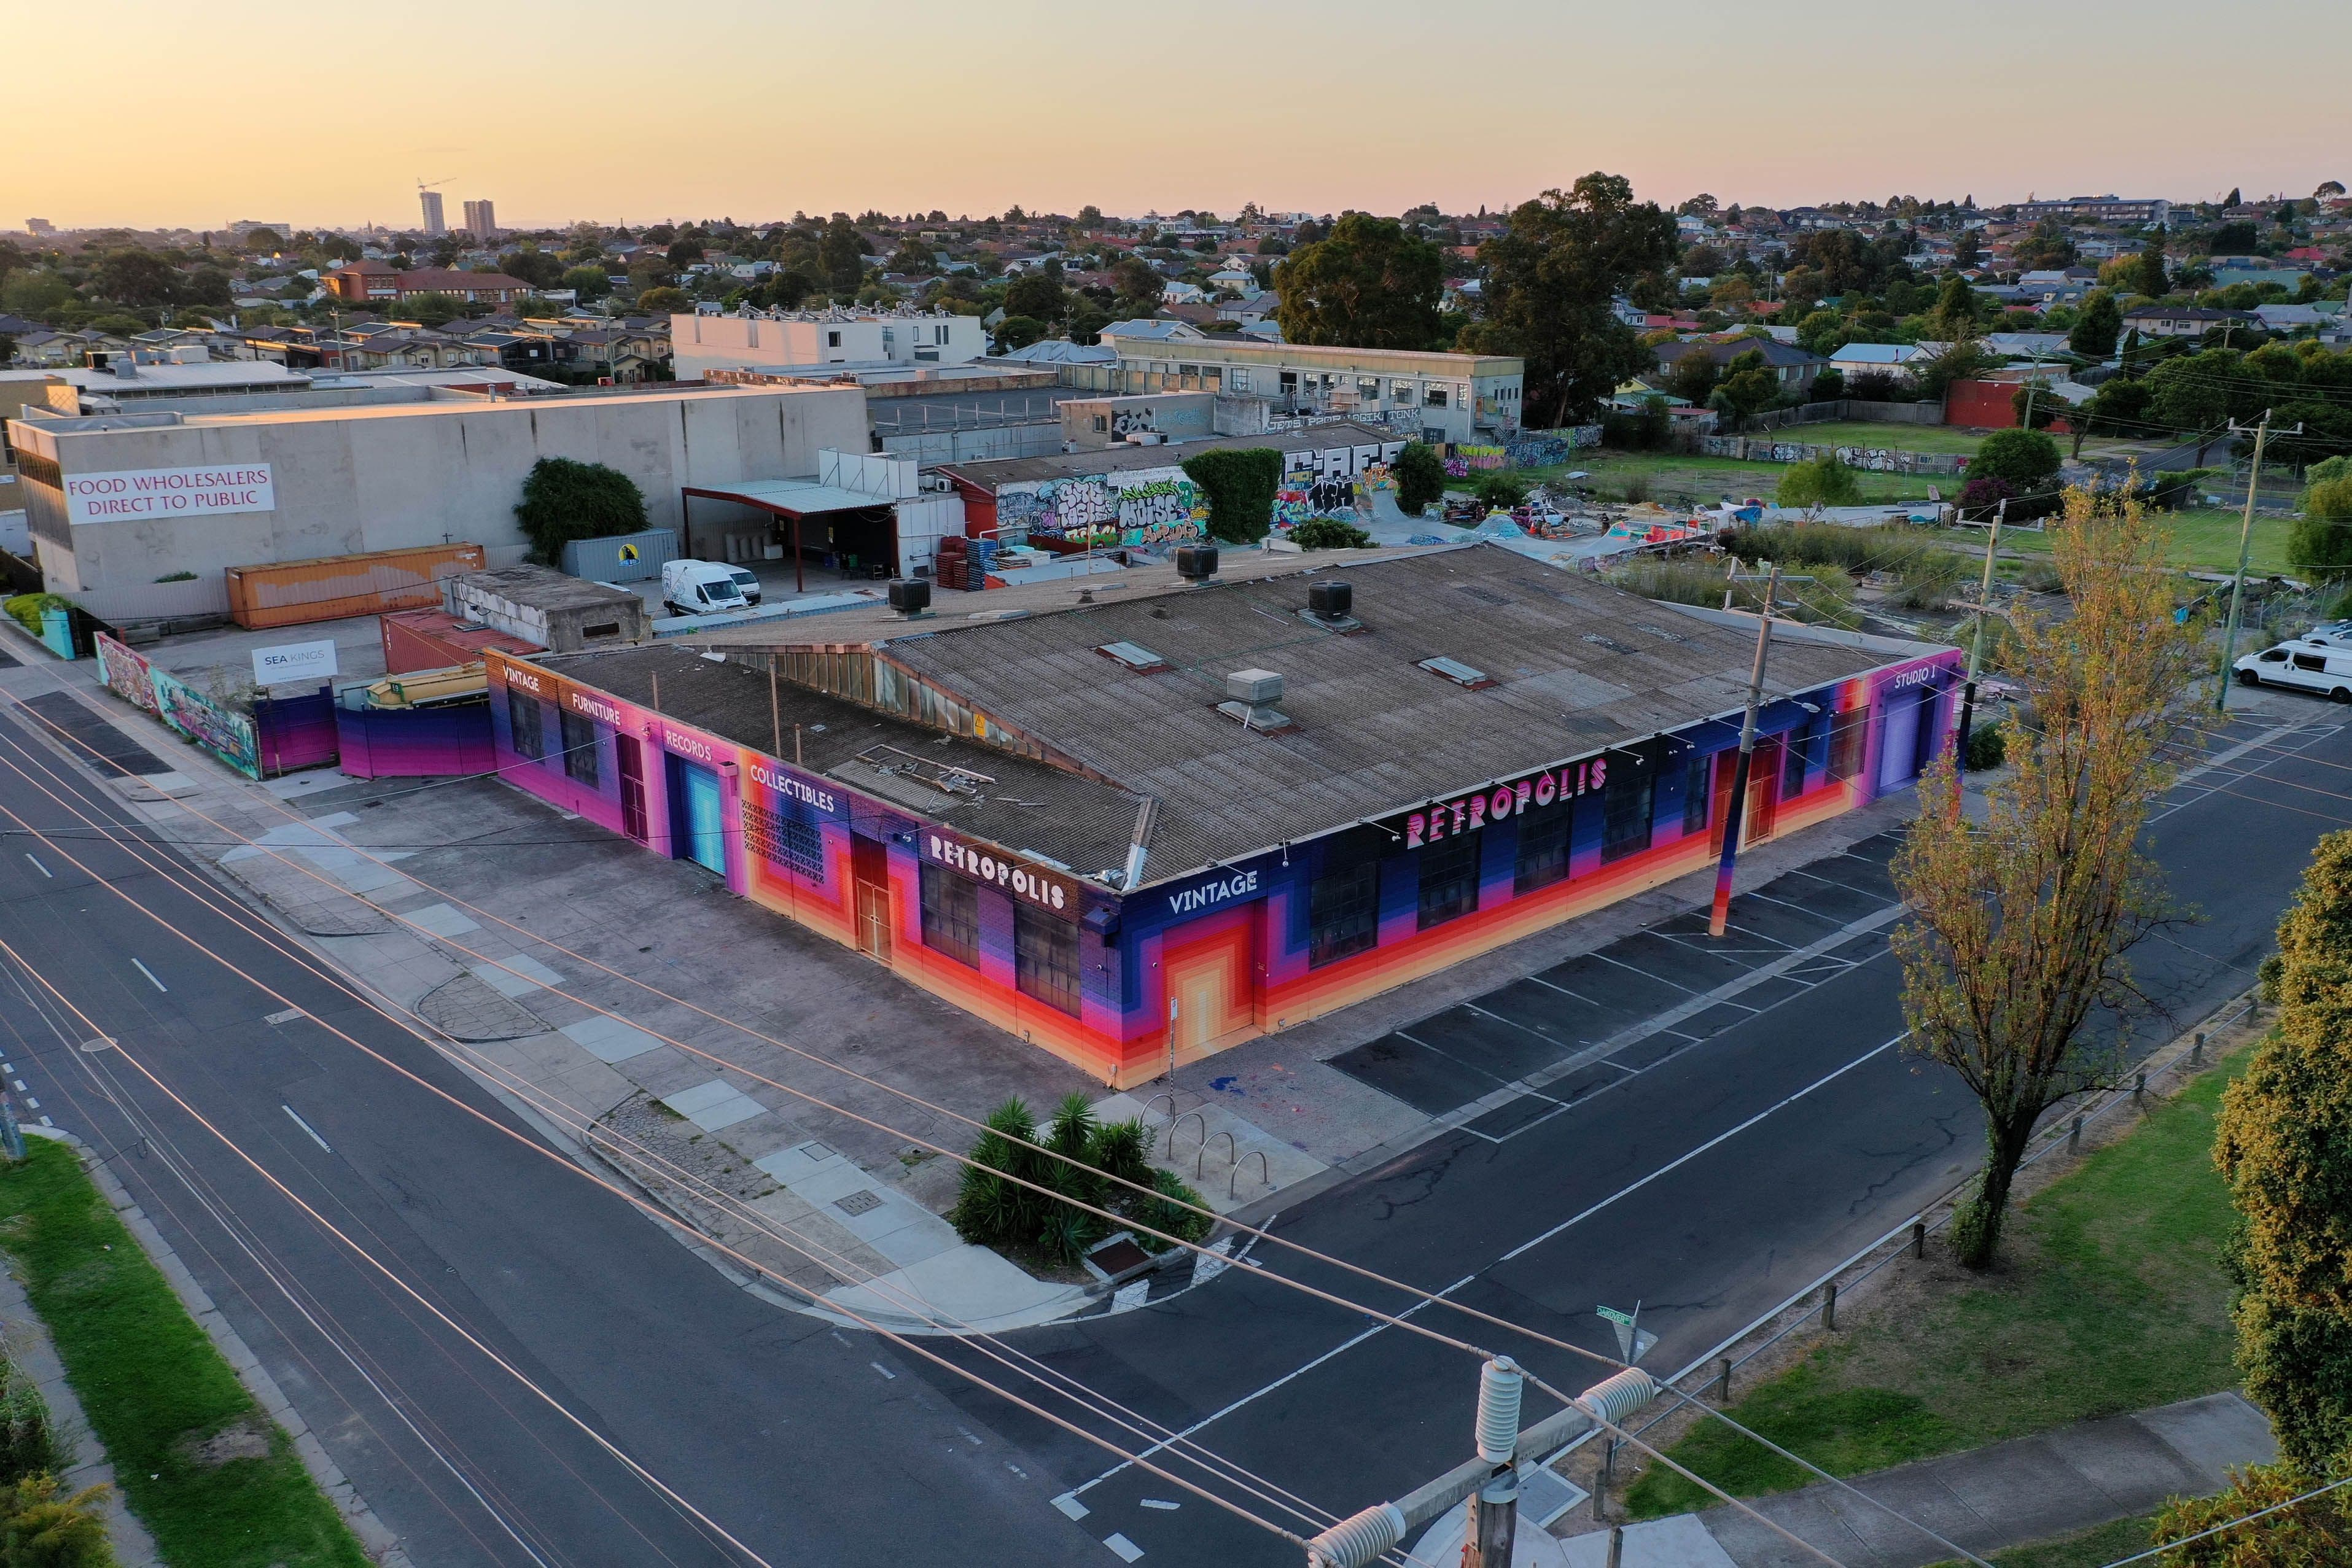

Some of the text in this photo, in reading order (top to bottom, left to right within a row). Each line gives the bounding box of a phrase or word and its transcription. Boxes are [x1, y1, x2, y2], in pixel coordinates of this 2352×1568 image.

[69, 470, 268, 495] FOOD WHOLESALERS
[88, 491, 258, 515] DIRECT TO PUBLIC
[265, 650, 325, 665] SEA KINGS
[503, 665, 540, 692] VINTAGE
[1894, 667, 1928, 689] STUDIO
[572, 693, 621, 726] FURNITURE
[666, 730, 712, 761] RECORDS
[750, 765, 835, 812] COLLECTIBLES
[1407, 758, 1607, 850] RETROPOLIS
[931, 835, 1064, 909] RETROPOLIS
[1169, 871, 1257, 914] VINTAGE
[1597, 1308, 1625, 1323] OAKOVER
